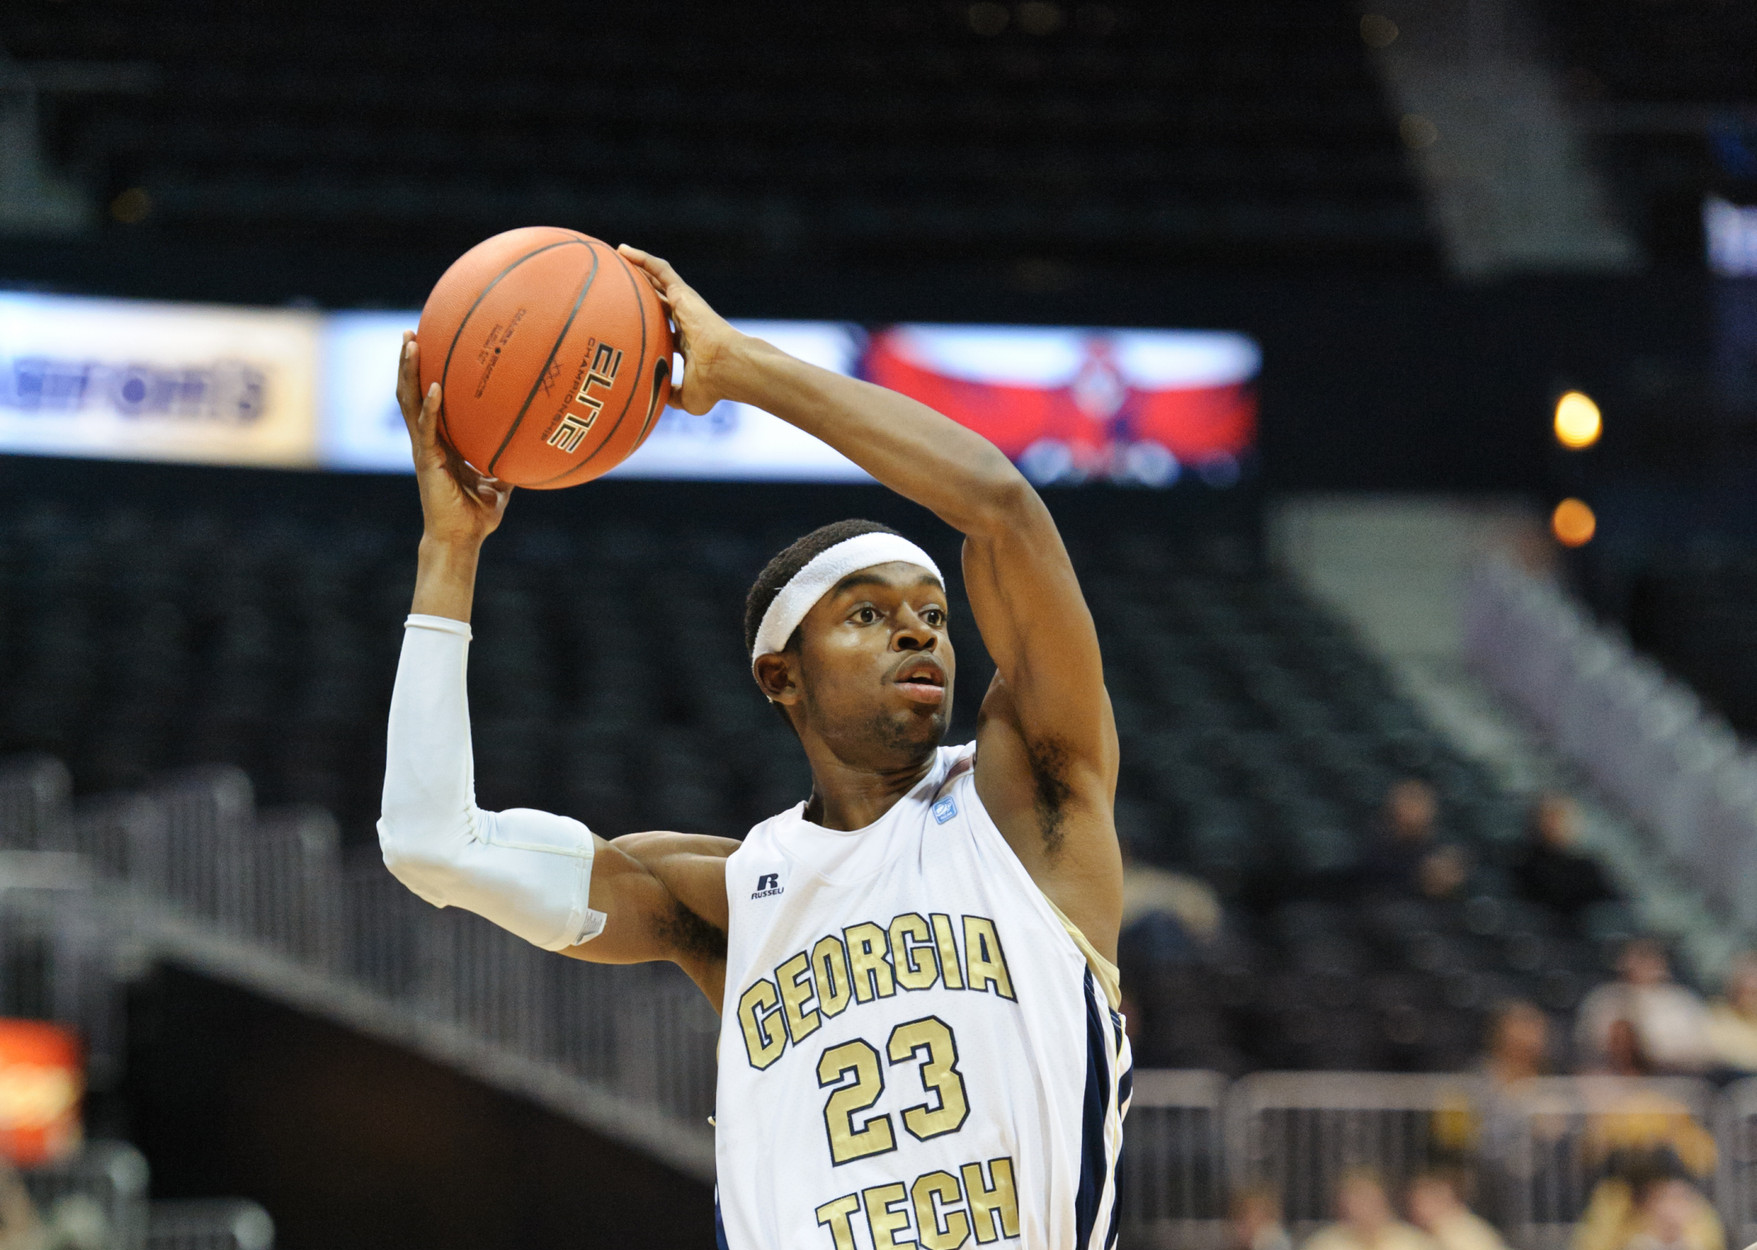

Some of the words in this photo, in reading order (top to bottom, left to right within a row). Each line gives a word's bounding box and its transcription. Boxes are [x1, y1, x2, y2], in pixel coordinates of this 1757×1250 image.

[541, 337, 596, 441] CHAMPIONSHIP
[547, 342, 624, 454] ELITE
[737, 912, 1019, 1071] GEORGIA
[816, 1014, 971, 1167] 23
